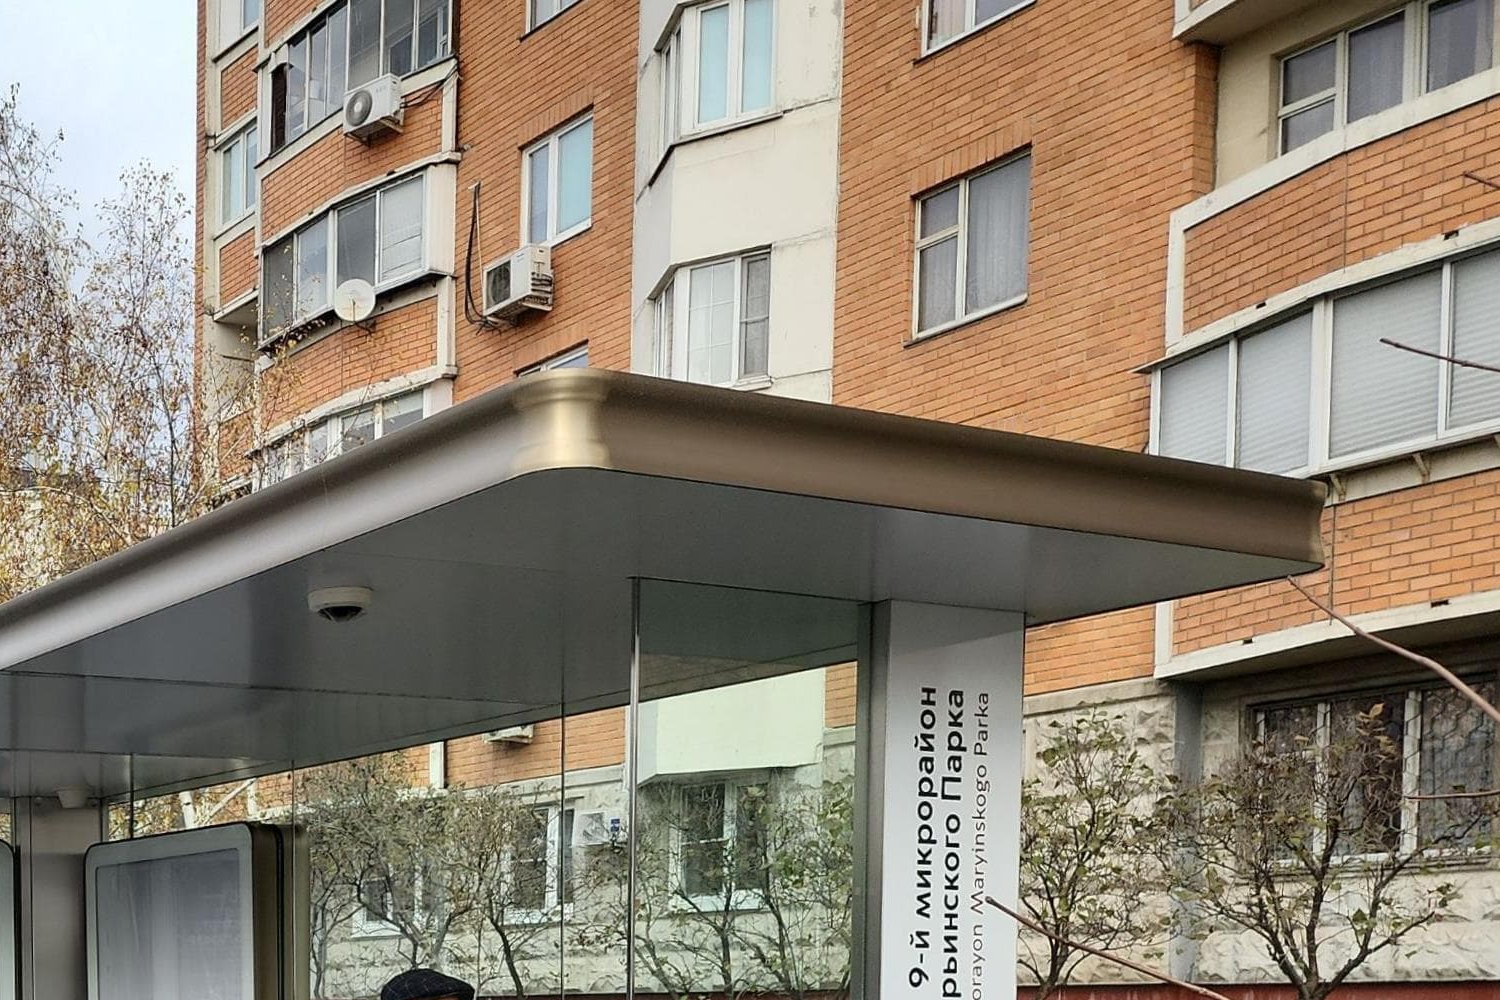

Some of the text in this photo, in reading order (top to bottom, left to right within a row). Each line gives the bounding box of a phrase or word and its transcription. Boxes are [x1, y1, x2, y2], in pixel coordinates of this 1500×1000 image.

[940, 689, 968, 801] Парка
[973, 692, 990, 756] Parka
[908, 686, 939, 988] 9-й микрорайон
[970, 764, 991, 915] Maryinskogo
